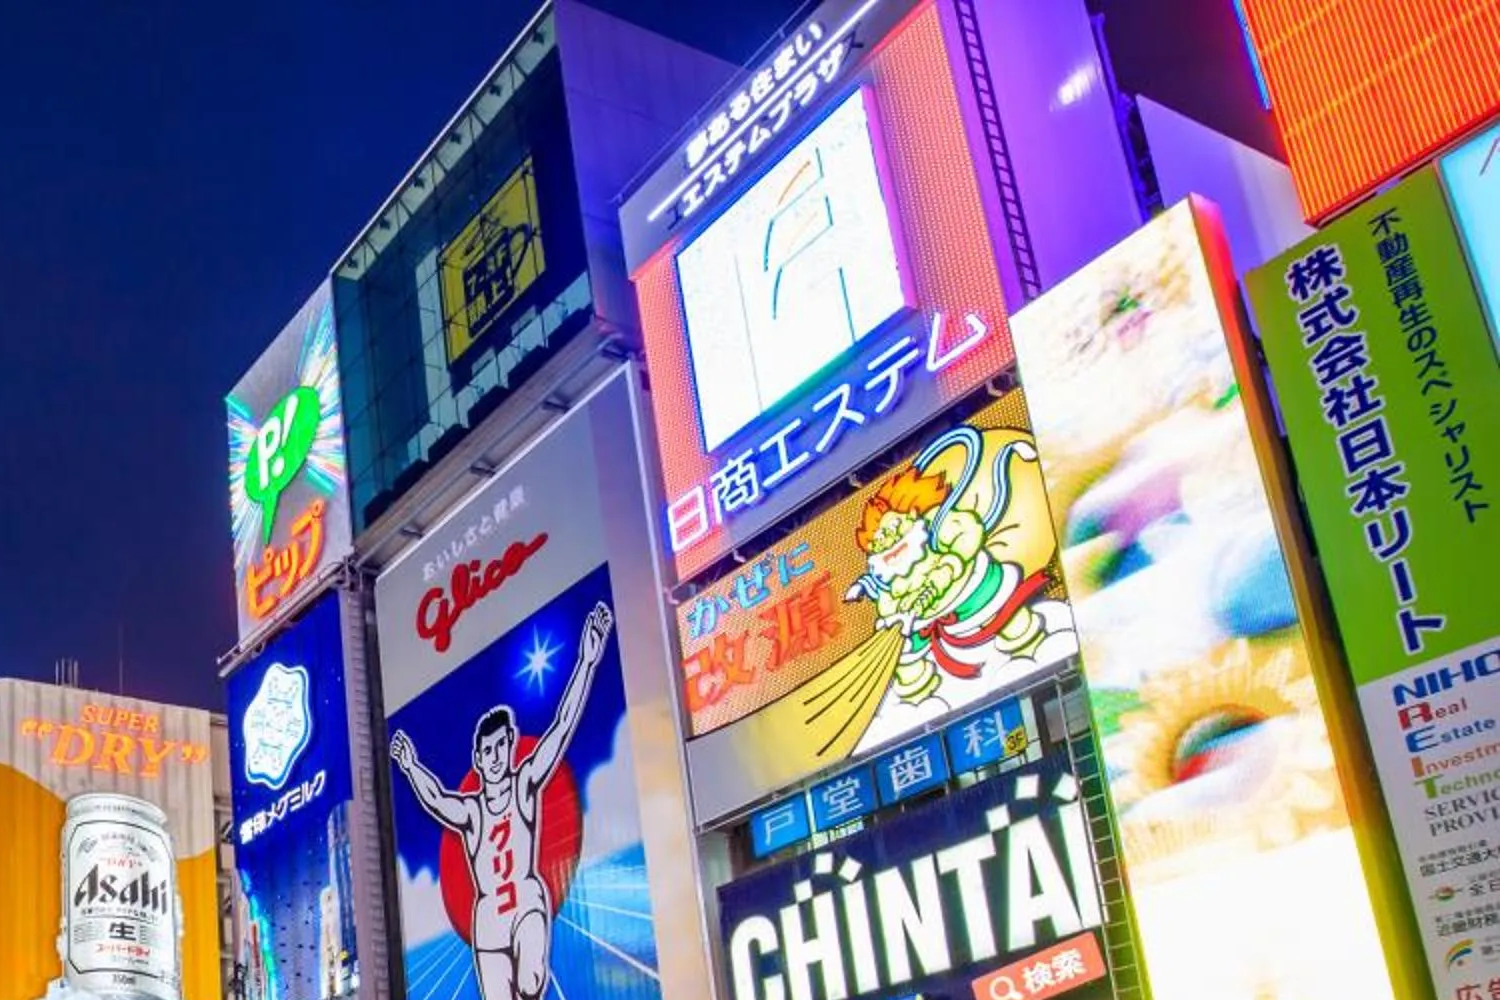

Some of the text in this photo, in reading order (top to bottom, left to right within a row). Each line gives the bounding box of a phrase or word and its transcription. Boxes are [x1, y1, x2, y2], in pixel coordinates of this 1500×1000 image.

[1368, 206, 1490, 524] 不動産再生のスペシャリスト
[668, 310, 987, 553] 日商エステム
[1287, 244, 1445, 654] 株式会社日本リート
[245, 500, 325, 619] ピップ
[415, 532, 548, 653] Glico
[685, 540, 814, 641] かぜに
[683, 570, 841, 714] 改源
[82, 704, 160, 733] SUPER
[1399, 697, 1468, 731] Real
[1406, 717, 1496, 753] Estate
[74, 863, 168, 915] Asahi
[487, 813, 517, 914] グリコ
[109, 922, 137, 941] 生
[1022, 948, 1087, 994] 検索
